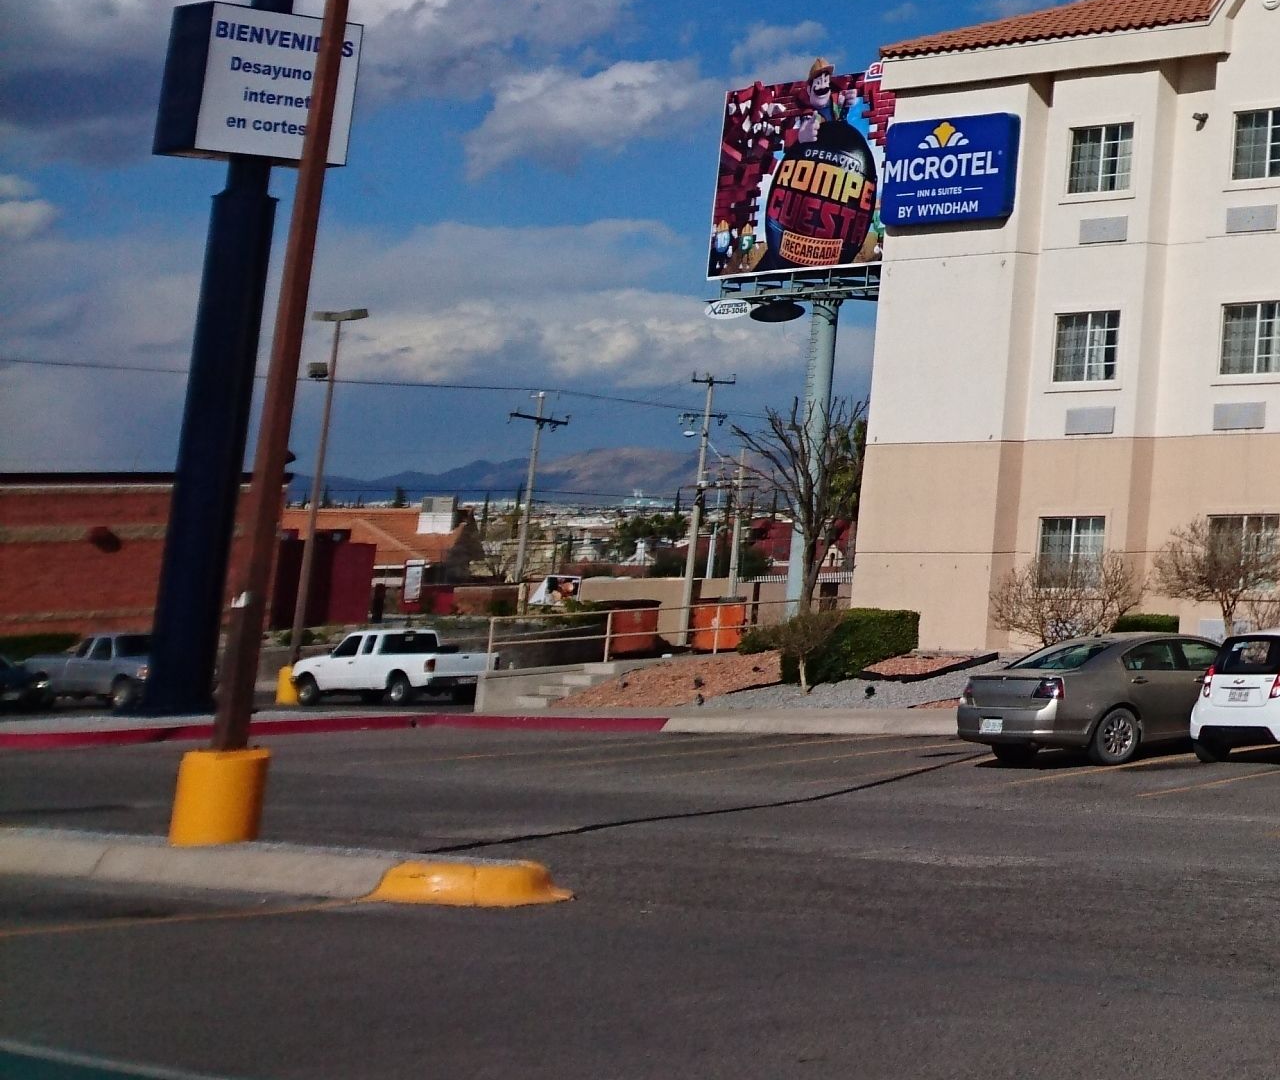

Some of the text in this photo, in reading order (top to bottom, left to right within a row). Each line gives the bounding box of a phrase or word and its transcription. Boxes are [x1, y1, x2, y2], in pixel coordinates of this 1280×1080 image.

[230, 56, 312, 80] Desayuno
[243, 87, 311, 109] internet
[226, 116, 246, 129] en
[884, 151, 999, 184] MICROTEL
[777, 159, 875, 210] ROMPE
[916, 186, 962, 198] INN & SUITES
[767, 188, 870, 244] CUESTA
[897, 200, 979, 218] BY WYNDHAM
[741, 235, 752, 250] 5
